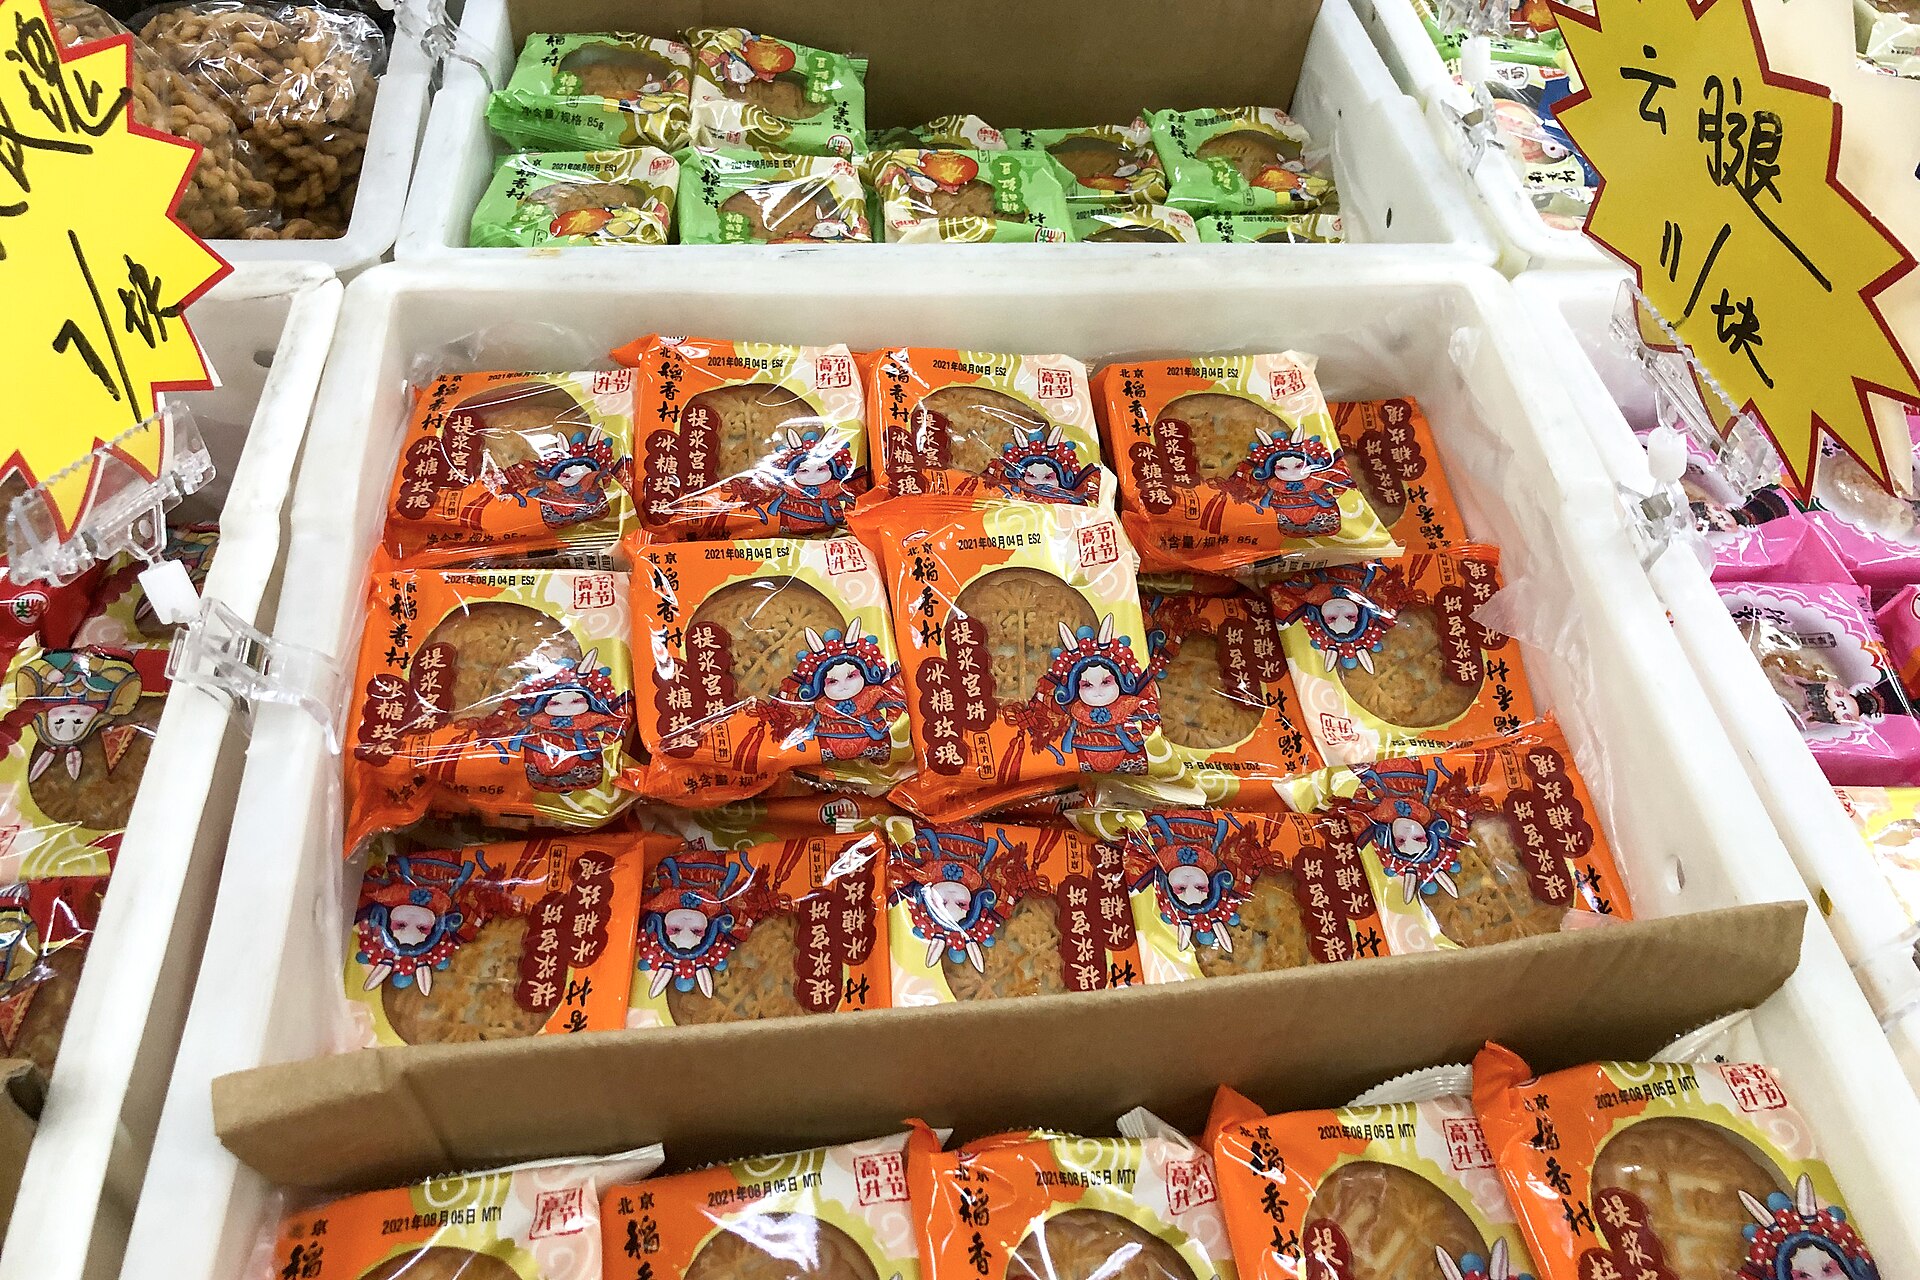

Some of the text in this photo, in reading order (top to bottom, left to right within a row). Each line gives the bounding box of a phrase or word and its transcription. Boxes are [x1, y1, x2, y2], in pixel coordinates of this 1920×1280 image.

[436, 374, 463, 382] 北京
[708, 356, 784, 370] 2021年08月04日 ES2
[932, 360, 1007, 377] 2021年08月04日 ES2
[1119, 368, 1145, 379] 北京
[1166, 366, 1239, 379] 2021年08月04日 ES2
[420, 383, 461, 432] 稻香村
[656, 362, 687, 424] 稻香村
[1121, 380, 1153, 437] 稻香村
[686, 407, 712, 489] 提浆宫饼
[1382, 403, 1419, 478] 冰糖玫瑰
[405, 440, 441, 510] 冰糖玫瑰
[1364, 440, 1403, 504] 提浆宫饼
[957, 533, 1042, 551] 2021年08月04日 ES2
[1406, 484, 1446, 543] 稻香村
[648, 552, 678, 565] 北京
[704, 547, 790, 561] 2021年08月04日 ES2
[907, 542, 934, 557] 北京
[389, 578, 418, 593] 北京
[444, 574, 535, 587] 2021年08月04日 ES2
[911, 557, 943, 648] 稻香村
[385, 594, 418, 670] 稻香村
[1443, 595, 1479, 683] 提浆宫饼
[692, 627, 727, 718] 提浆宫饼
[950, 620, 988, 723] 提浆宫饼
[1485, 658, 1523, 734] 稻香村
[925, 660, 965, 766] 冰糖玫瑰
[1196, 761, 1262, 772] 2021年08月04日
[1528, 753, 1584, 853] 冰糖玫瑰
[1321, 818, 1370, 914] 冰糖玫瑰
[1513, 801, 1568, 900] 提浆宫饼
[571, 856, 606, 963] 冰糖玫瑰
[1094, 844, 1131, 946] 冰糖玫瑰
[1302, 857, 1347, 963] 提浆宫饼
[527, 904, 564, 1007] 提浆宫饼
[804, 901, 836, 1006] 提浆宫饼
[1067, 885, 1102, 991] 提浆宫饼
[1355, 926, 1383, 958] 村
[1595, 1076, 1700, 1110] 2021年08月05日 MT1
[1239, 1125, 1272, 1141] 北京
[1317, 1123, 1416, 1141] 2021年08月05日 MT1
[618, 1192, 655, 1215] 北京
[707, 1171, 823, 1207] 2021年08月05日 MT1
[1035, 1169, 1136, 1188] 2021年08月05日 MT1
[1529, 1116, 1597, 1237] 稻香村
[381, 1206, 502, 1235] 2021年08月05日 MT1
